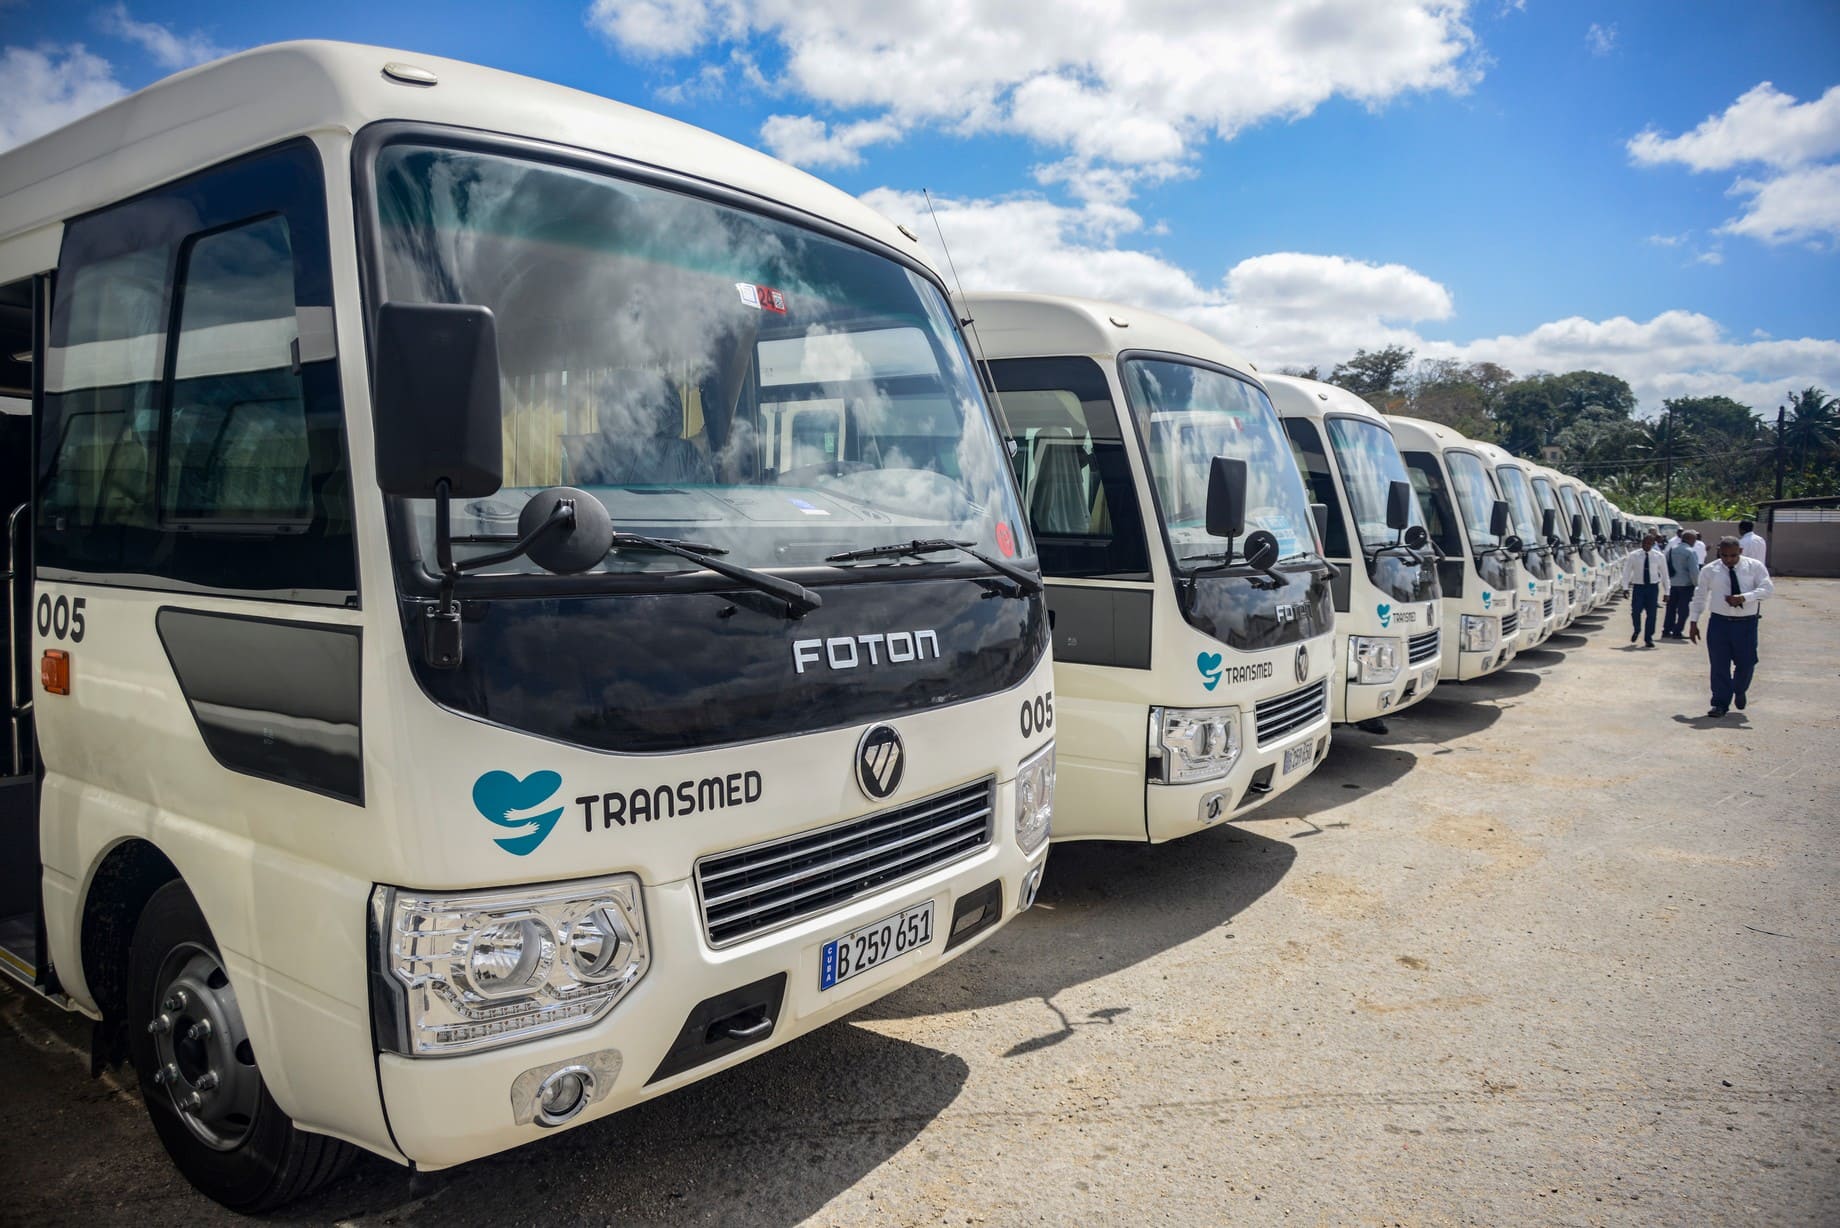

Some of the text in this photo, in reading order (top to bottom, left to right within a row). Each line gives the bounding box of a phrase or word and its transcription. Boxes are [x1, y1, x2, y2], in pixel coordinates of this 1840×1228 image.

[37, 592, 86, 643] 005
[793, 629, 940, 674] FOTON
[1225, 661, 1273, 685] TRANSMED
[1020, 691, 1053, 739] 005
[575, 770, 762, 833] TRANSMED
[825, 947, 833, 981] CUBA
[837, 909, 930, 979] B 259 651
